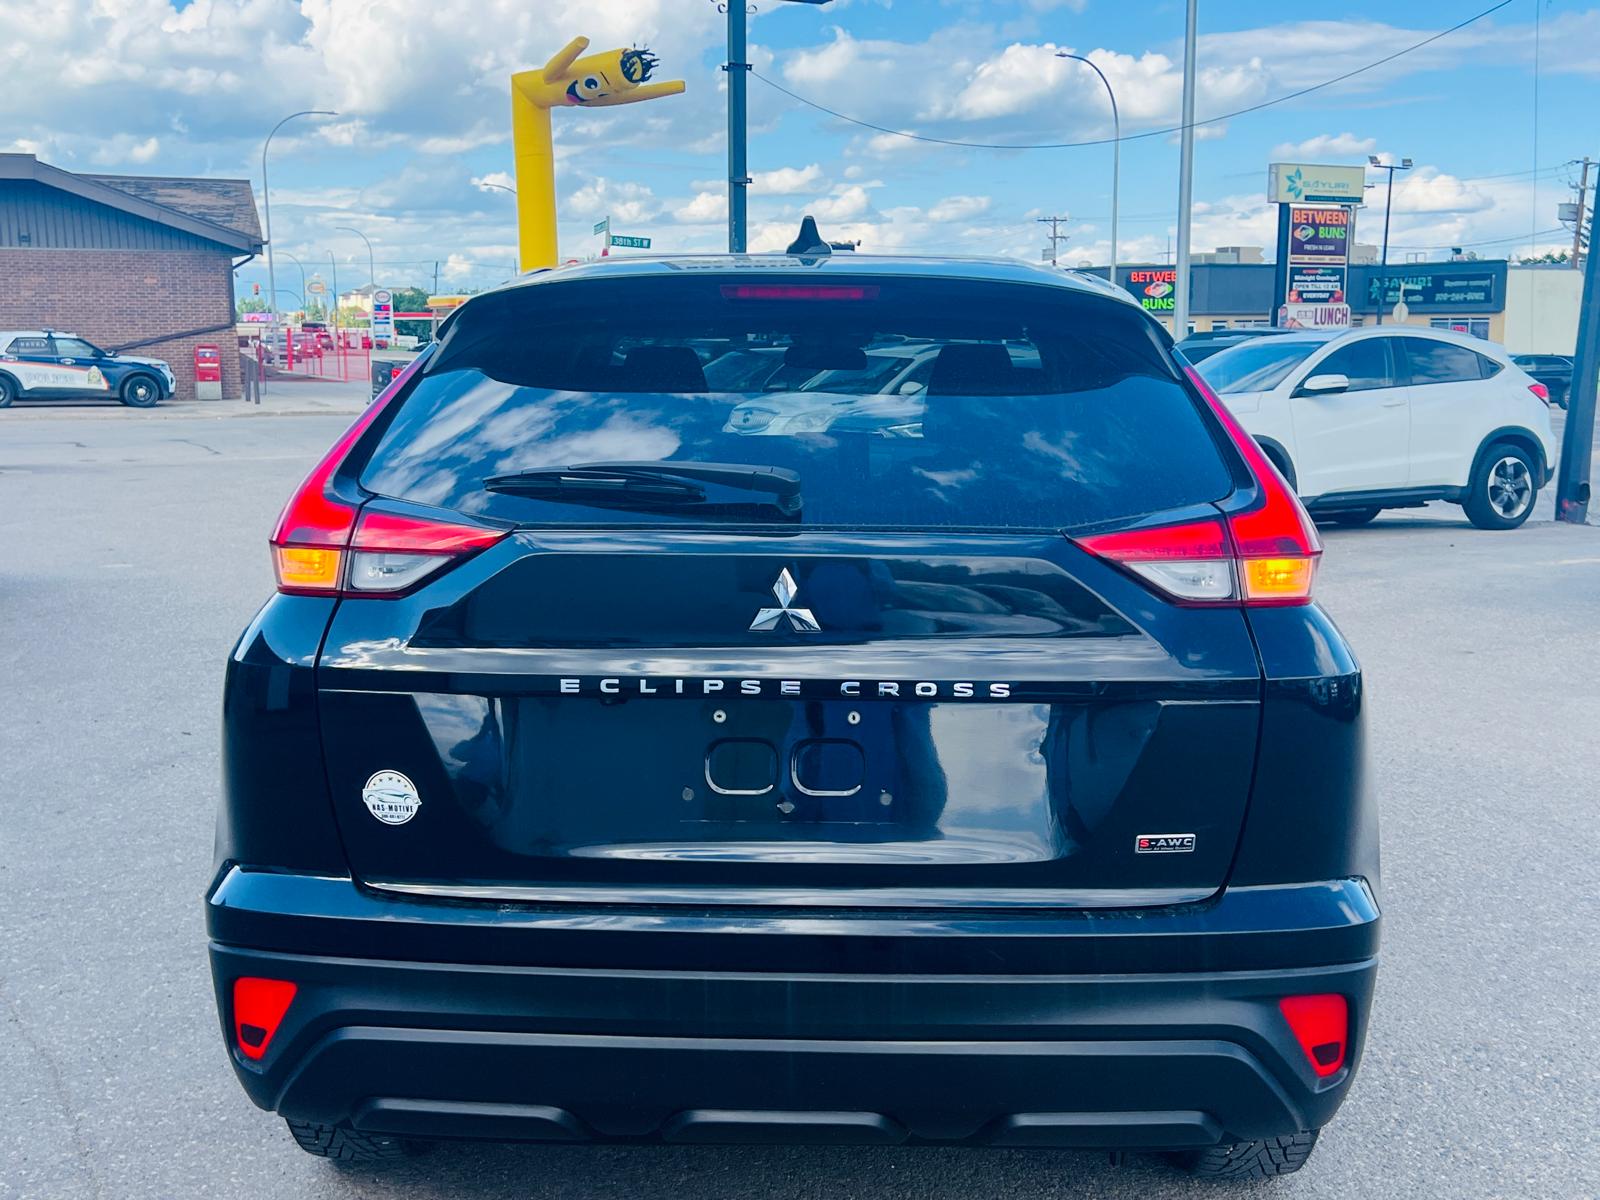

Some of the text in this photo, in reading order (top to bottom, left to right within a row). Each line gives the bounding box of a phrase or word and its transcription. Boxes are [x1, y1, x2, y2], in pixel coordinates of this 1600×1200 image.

[1293, 209, 1348, 225] BETWEEN
[1318, 226, 1346, 239] BUNS
[1131, 271, 1176, 283] BETWEE
[1142, 298, 1175, 310] BUNS
[1314, 306, 1348, 326] LUNCH
[560, 678, 1011, 698] ECLIPSE CROSS
[1139, 838, 1193, 848] S-AWC
